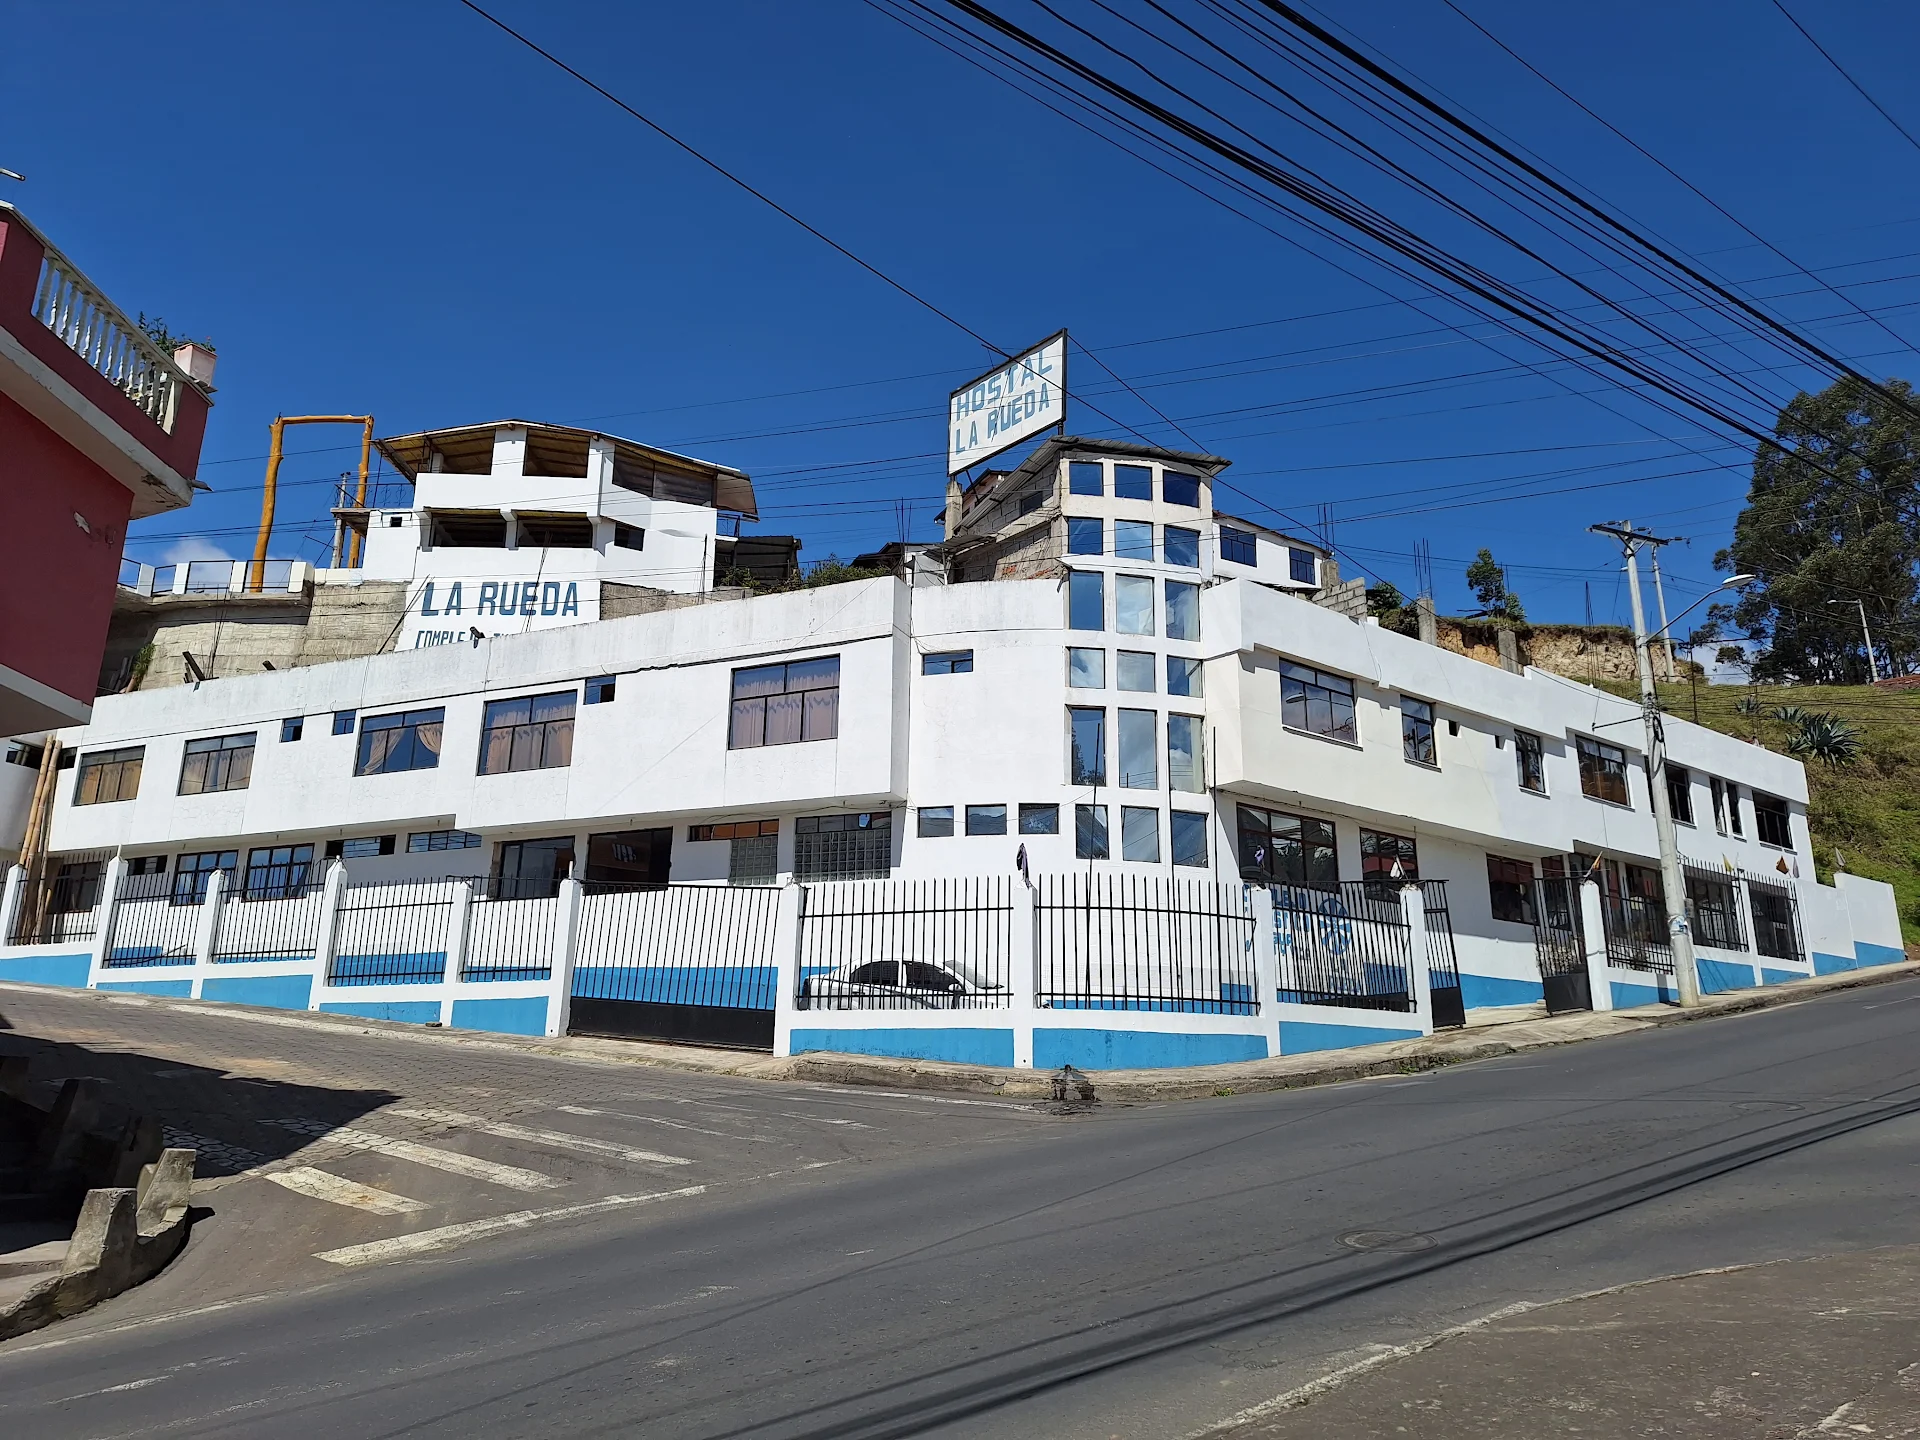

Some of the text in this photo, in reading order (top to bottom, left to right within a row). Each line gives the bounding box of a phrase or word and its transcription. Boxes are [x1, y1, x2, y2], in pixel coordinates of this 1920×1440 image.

[956, 350, 1052, 421] HOSTAL
[956, 382, 1050, 455] LA RUEDA
[421, 581, 578, 616] LA RUEDA
